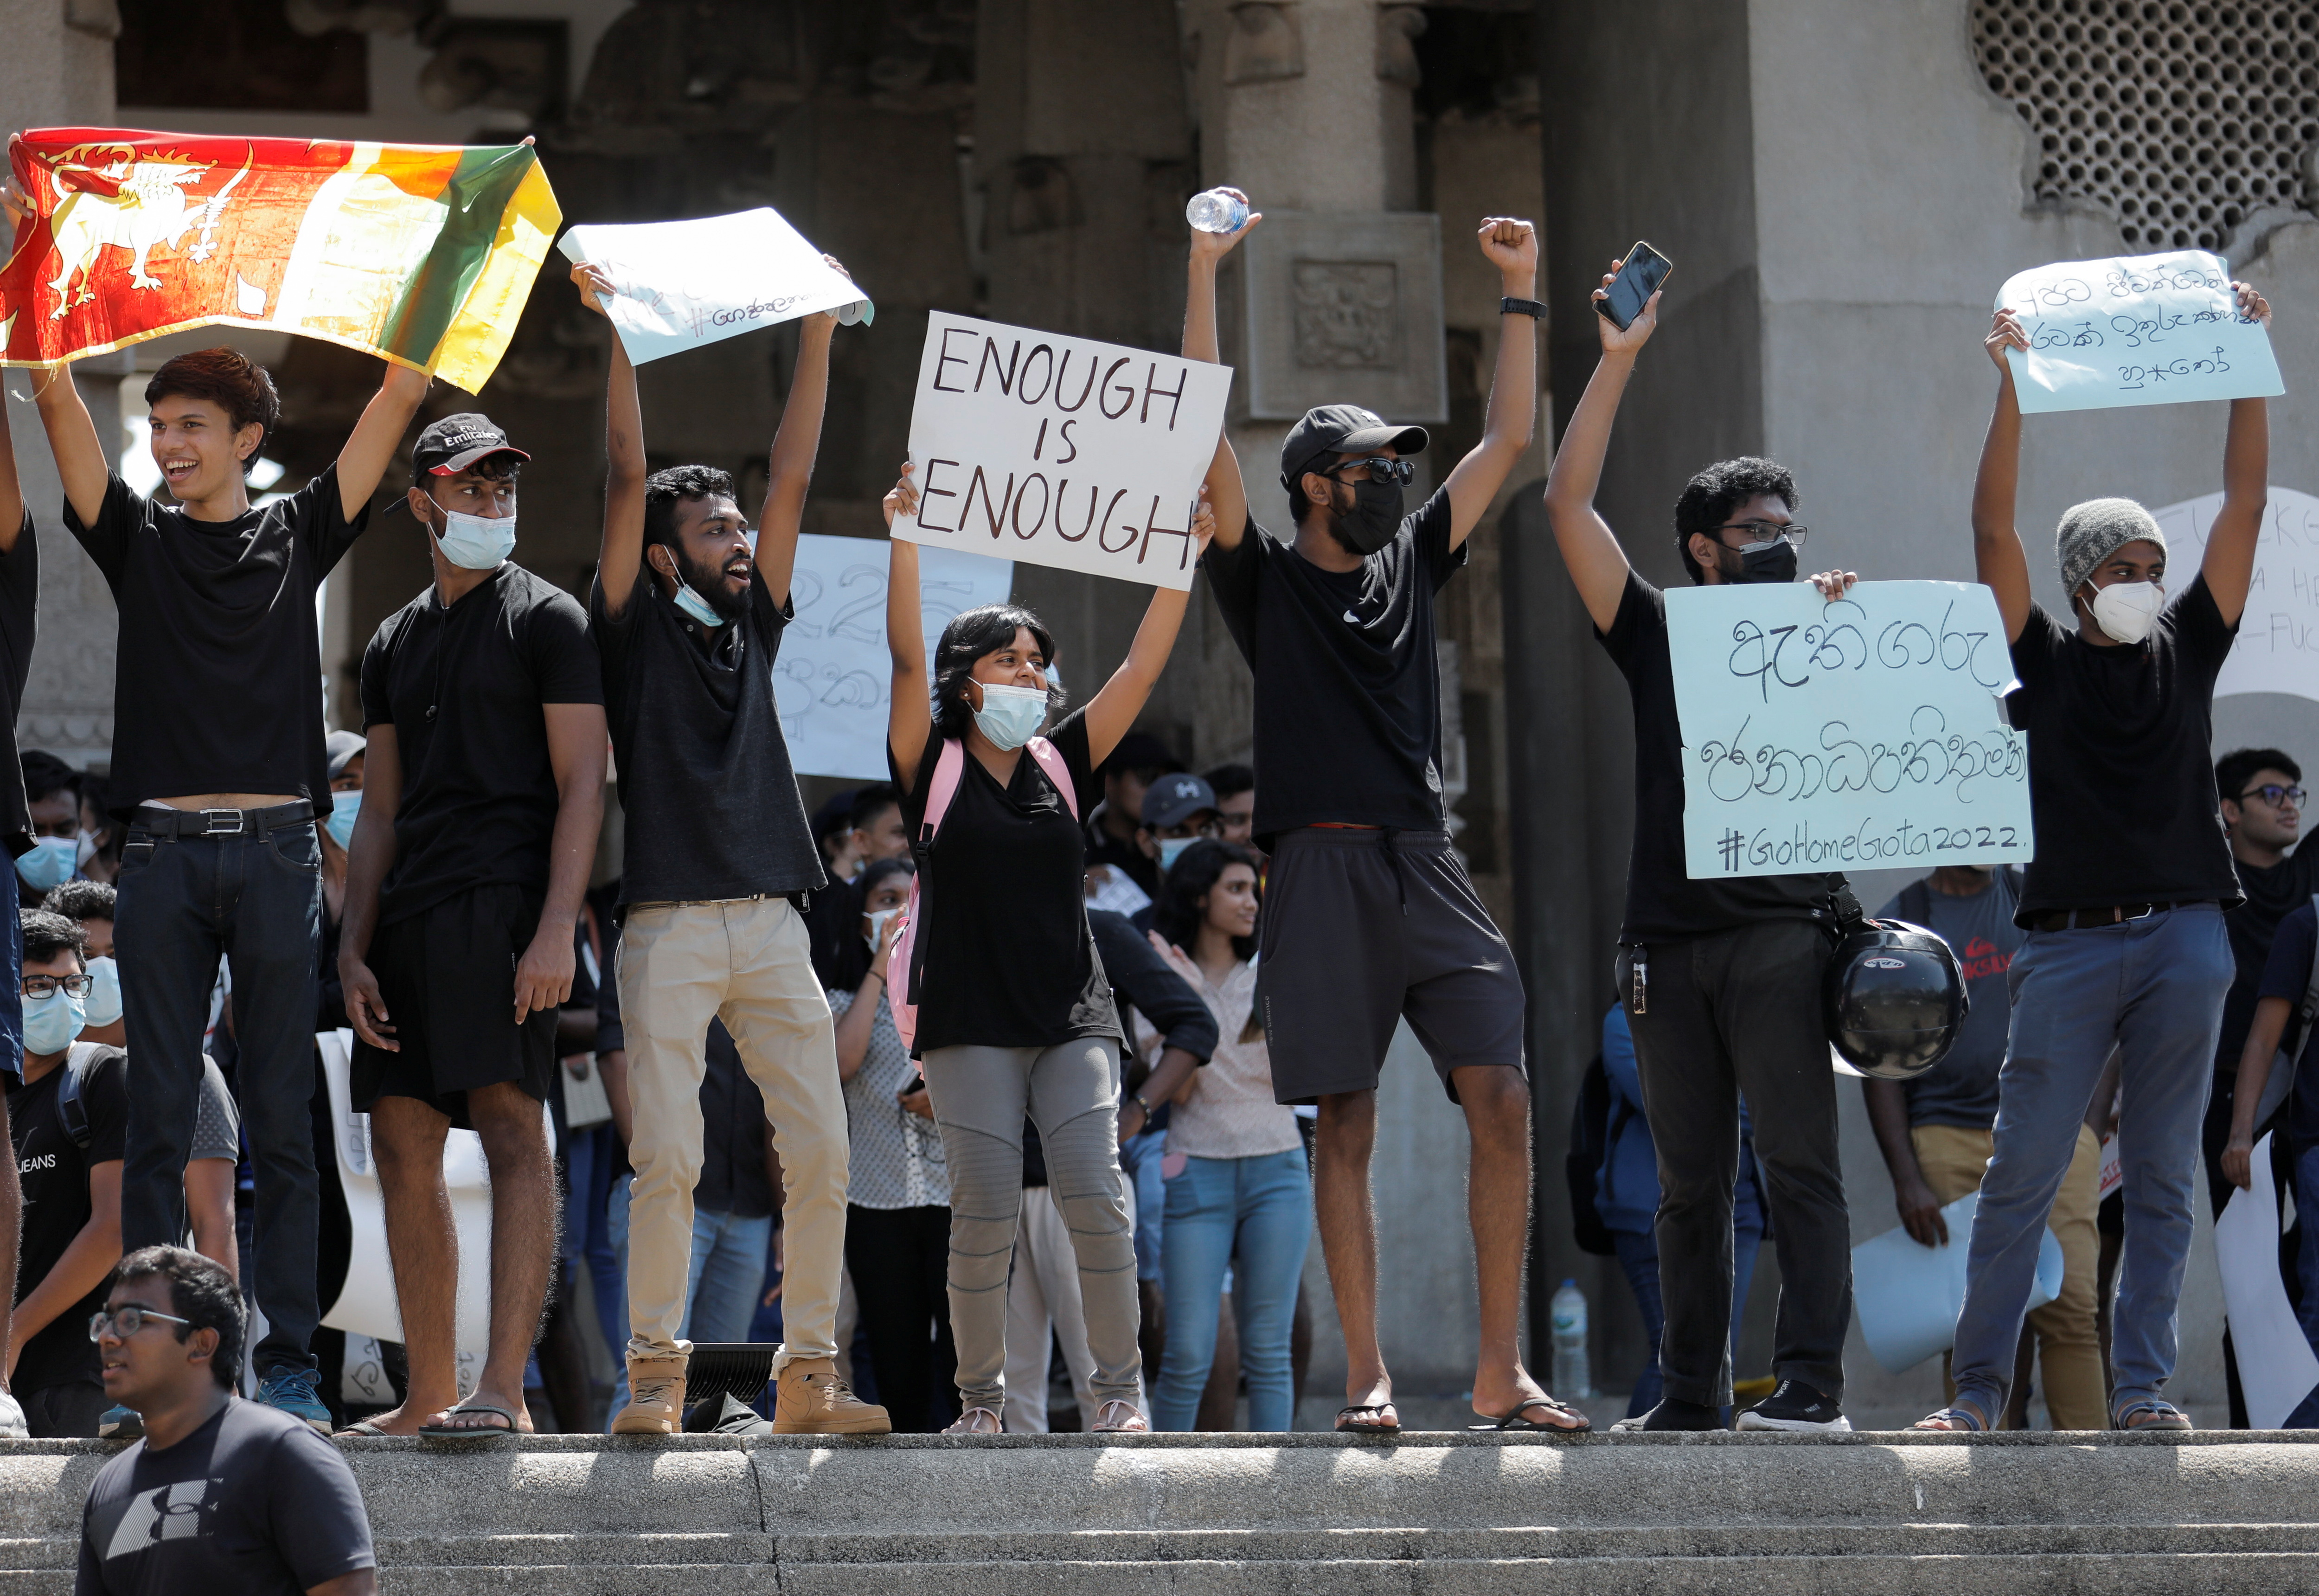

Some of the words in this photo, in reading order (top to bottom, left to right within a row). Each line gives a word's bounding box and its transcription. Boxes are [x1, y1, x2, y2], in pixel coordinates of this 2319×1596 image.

[933, 327, 1187, 431] ENOUGH
[443, 430, 498, 448] Emirates
[1033, 417, 1076, 464] IS
[917, 458, 1194, 570] ENOUGH
[687, 589, 699, 601] METRO
[18, 1154, 56, 1174] JEANS
